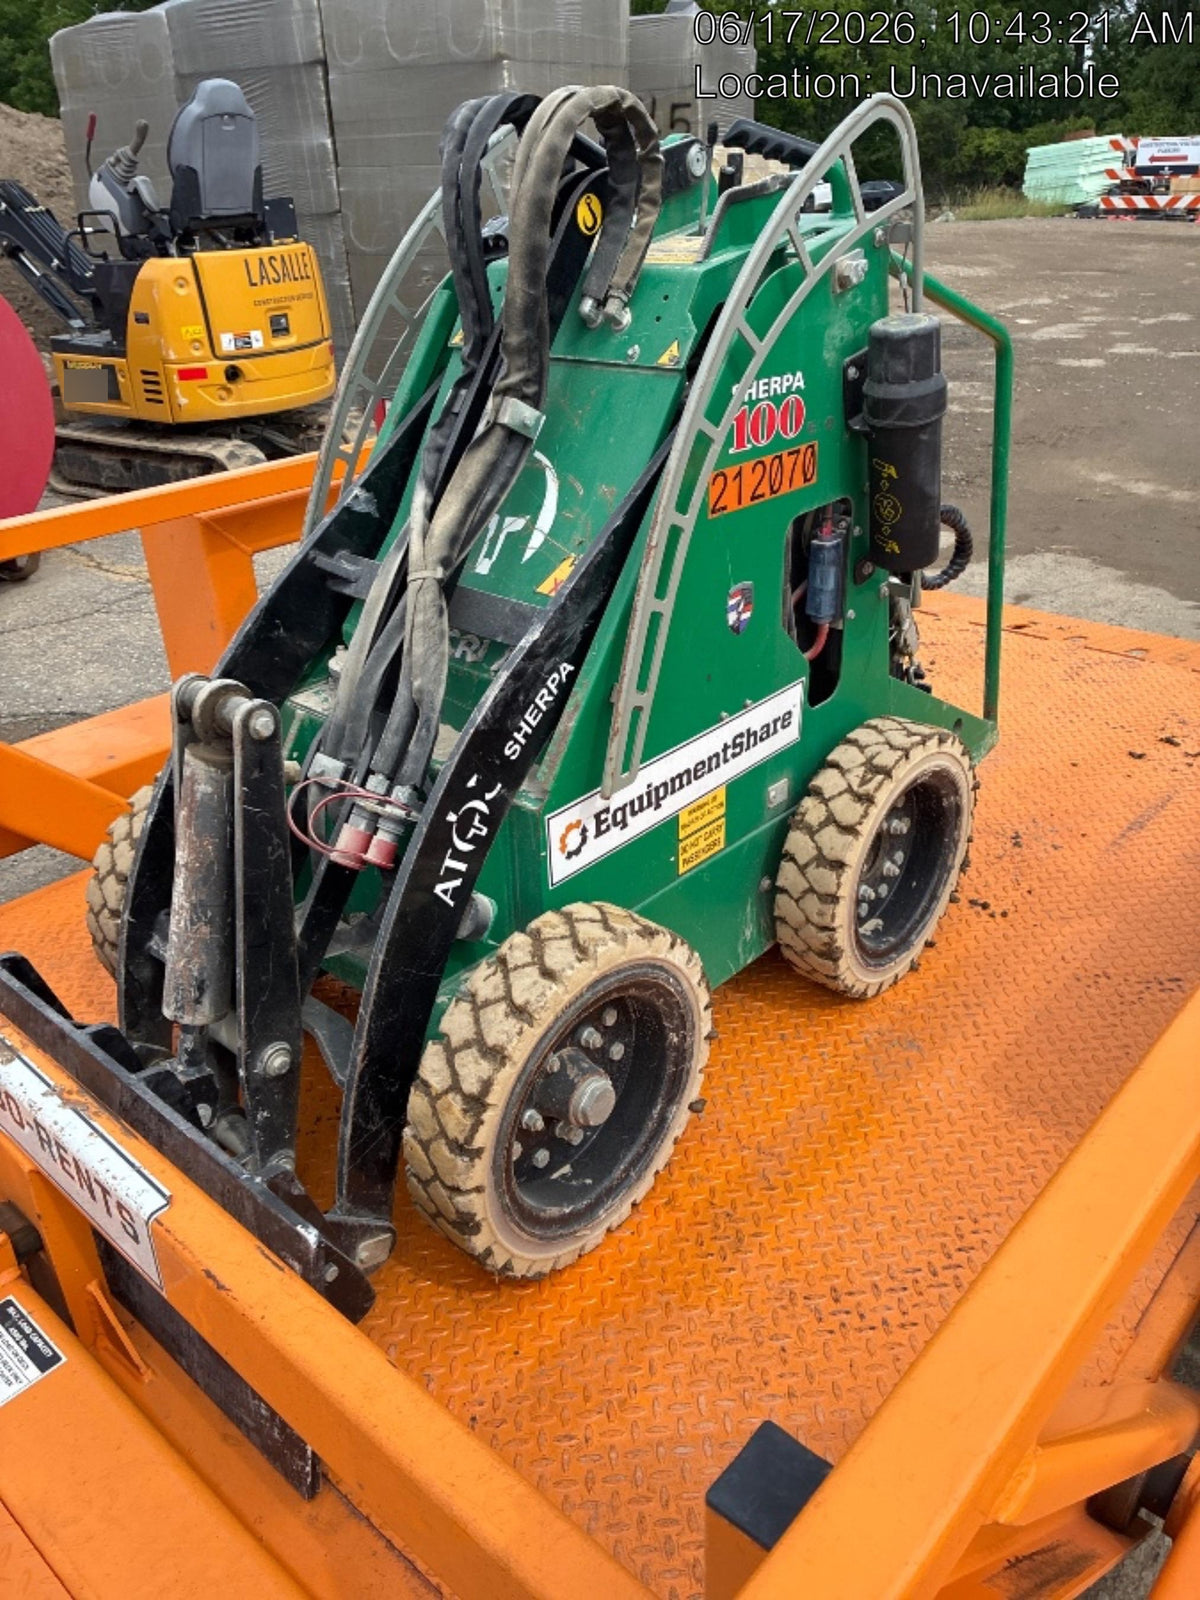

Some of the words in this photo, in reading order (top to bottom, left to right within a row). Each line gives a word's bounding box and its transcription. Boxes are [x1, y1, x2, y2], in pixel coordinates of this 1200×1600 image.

[244, 252, 311, 287] LASALLE
[729, 394, 806, 454] 100
[711, 444, 816, 515] 212070
[504, 661, 575, 761] SHERPA
[593, 710, 793, 839] EquipmentShare
